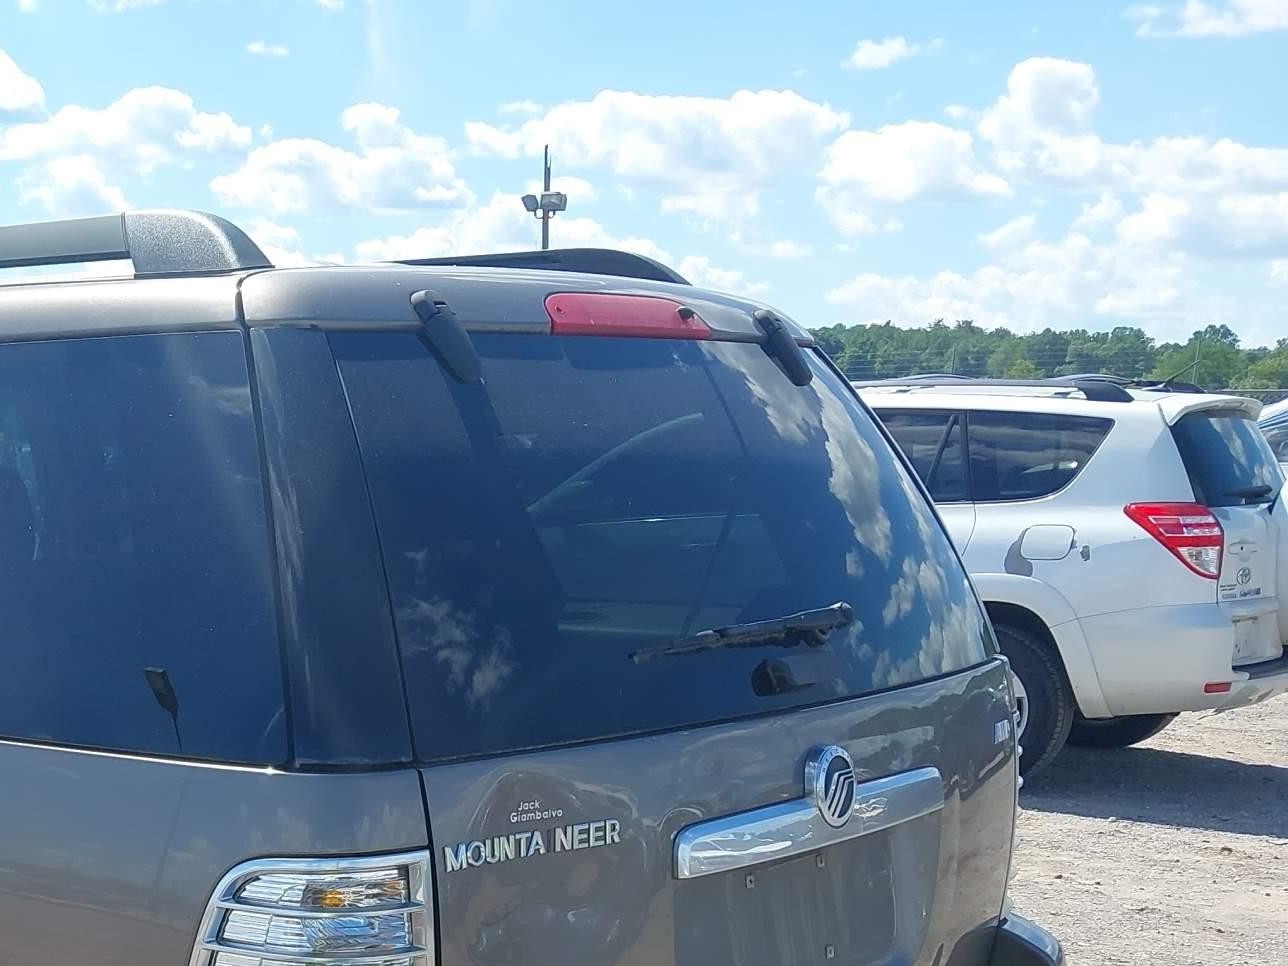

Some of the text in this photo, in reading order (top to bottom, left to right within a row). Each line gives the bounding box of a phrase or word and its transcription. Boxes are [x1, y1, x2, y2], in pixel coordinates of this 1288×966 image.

[518, 800, 541, 811] Jack
[510, 809, 563, 823] Giambalvo
[444, 819, 621, 873] MOUNTA NEER
